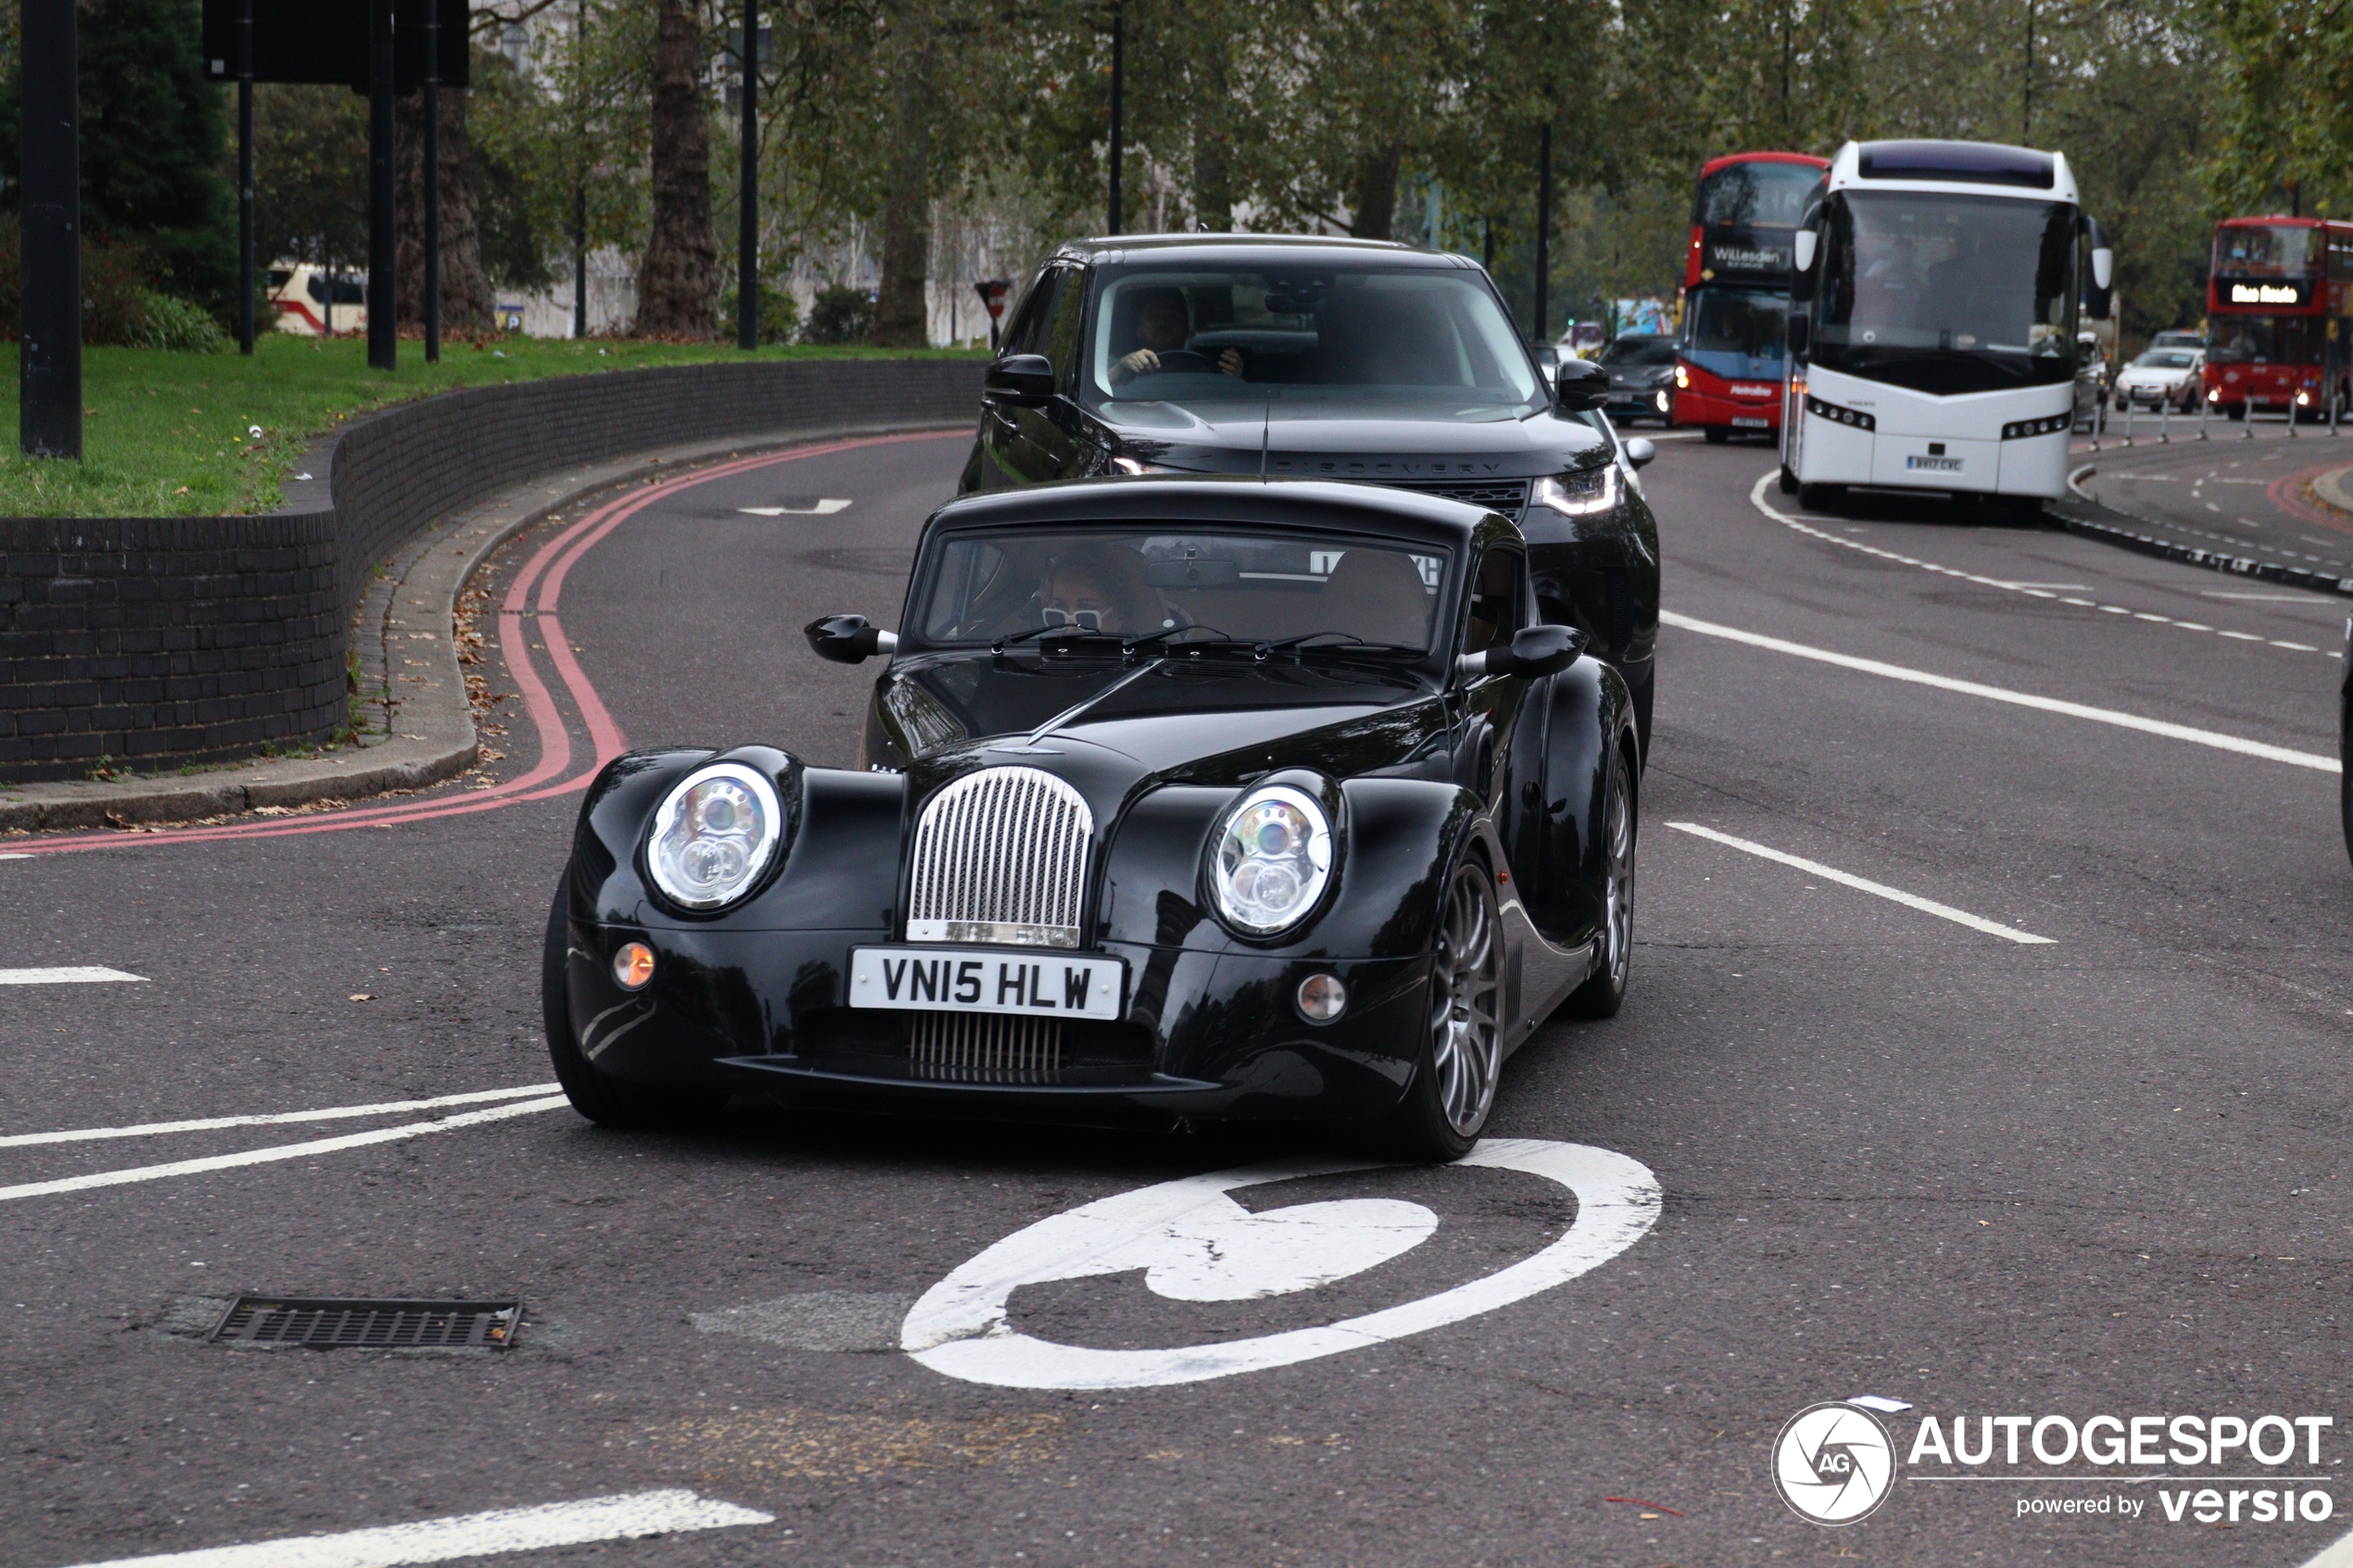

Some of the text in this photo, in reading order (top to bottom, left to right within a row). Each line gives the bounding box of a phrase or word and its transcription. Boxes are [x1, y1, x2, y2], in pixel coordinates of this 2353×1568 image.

[1714, 246, 1780, 262] Willesden
[1730, 385, 1772, 397] Metroline
[1276, 461, 1501, 475] DISCOVERY
[883, 959, 1091, 1010] VN15 HLW
